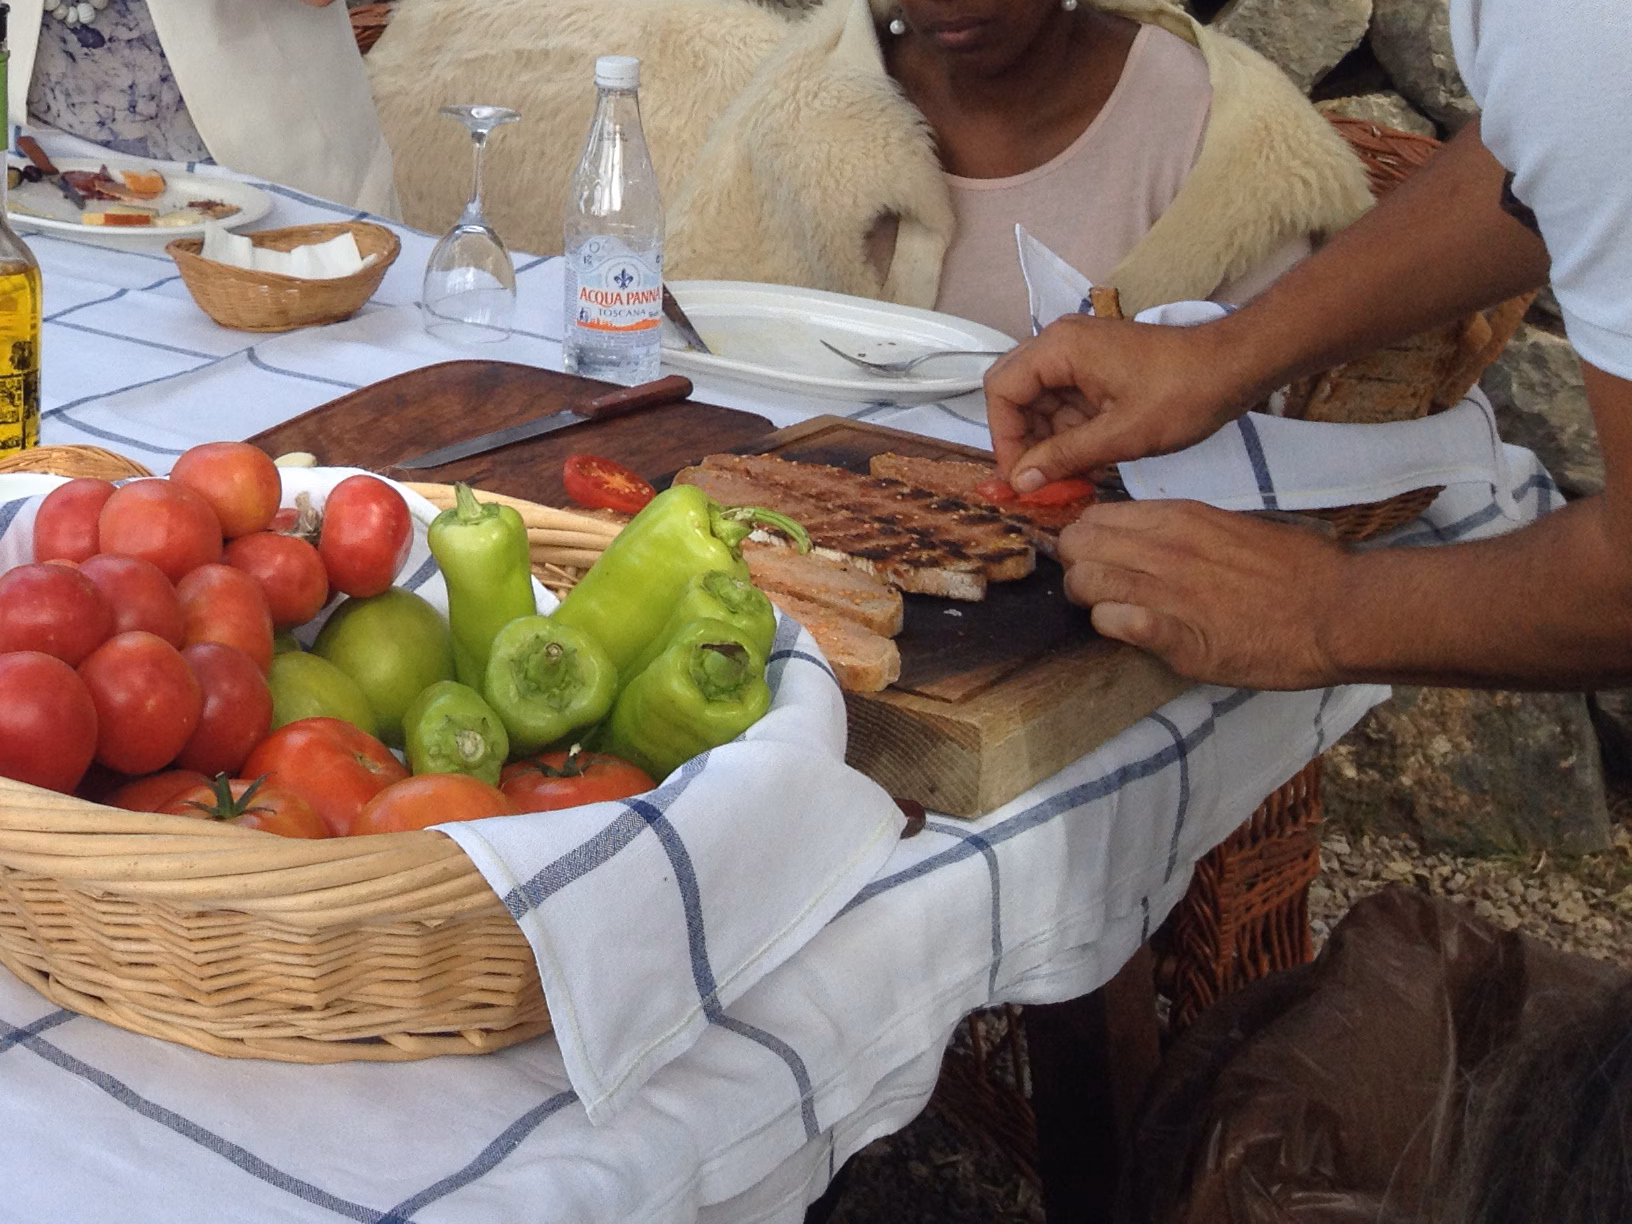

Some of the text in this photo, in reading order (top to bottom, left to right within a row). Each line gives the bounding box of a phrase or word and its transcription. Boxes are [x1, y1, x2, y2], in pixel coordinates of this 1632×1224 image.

[580, 286, 661, 308] ACQUA PANNA
[598, 308, 647, 318] TOSCANA
